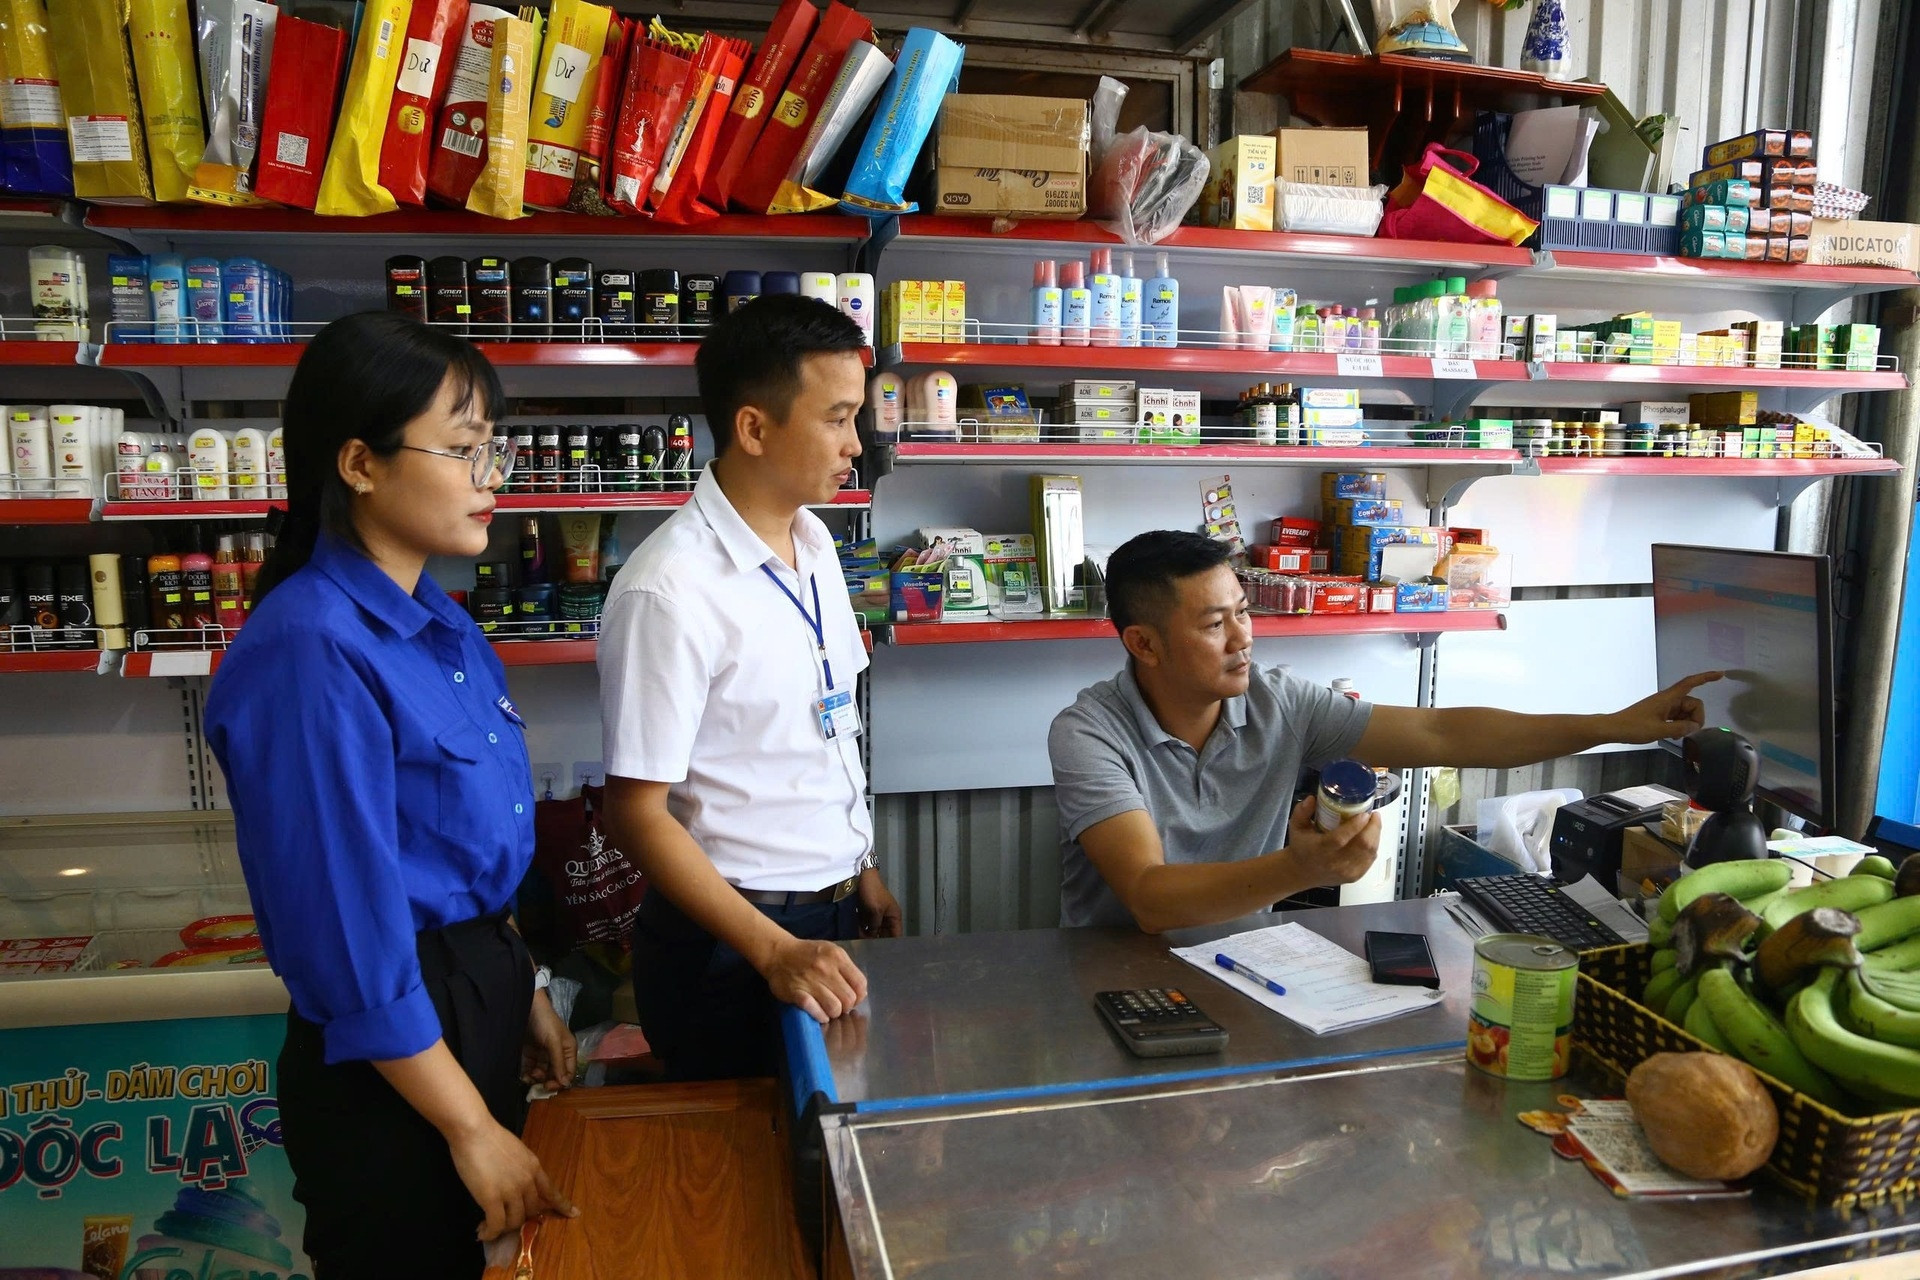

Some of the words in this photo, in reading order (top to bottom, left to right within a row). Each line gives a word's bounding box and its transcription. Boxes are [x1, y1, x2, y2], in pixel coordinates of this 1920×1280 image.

[746, 89, 761, 109] GIN
[789, 98, 805, 119] GIN
[410, 109, 421, 126] GIN
[946, 195, 969, 203] PACK
[1045, 190, 1069, 199] 327919
[1069, 190, 1080, 199] MY
[1044, 199, 1068, 208] 330087
[1069, 200, 1080, 208] VN
[112, 286, 144, 295] Gillette
[1643, 405, 1687, 414] Phosphalugel
[61, 436, 78, 444] Dove
[1282, 527, 1310, 537] EVEREADY
[29, 594, 54, 602] AXE
[61, 594, 84, 602] AXE
[1327, 594, 1354, 602] EVEREADY
[11, 1069, 87, 1114] THỬ
[178, 1060, 267, 1097] CHƠI
[147, 1103, 249, 1191] LẠ
